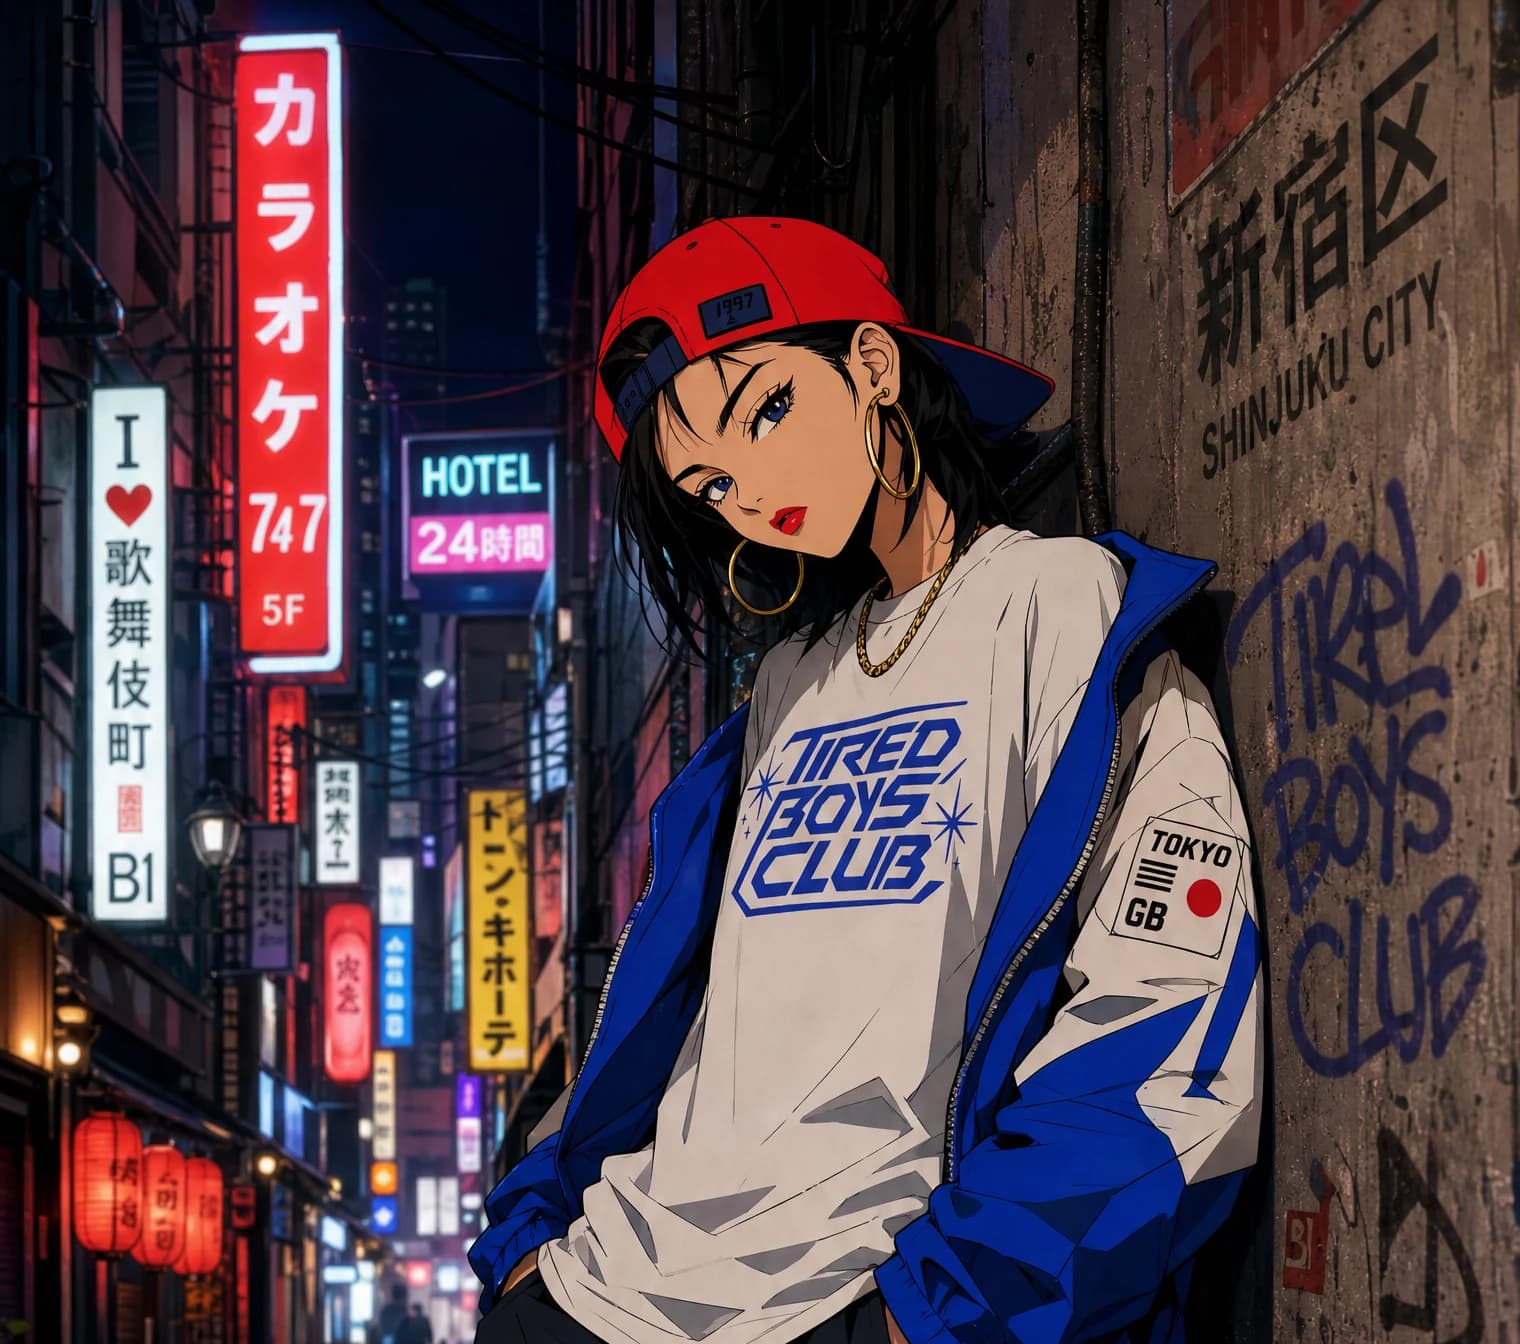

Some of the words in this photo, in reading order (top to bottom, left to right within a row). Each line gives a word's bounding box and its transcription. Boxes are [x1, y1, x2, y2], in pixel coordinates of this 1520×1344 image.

[1196, 33, 1448, 386] 新宿区
[252, 73, 318, 452] カラオケ
[716, 291, 753, 318] 1997
[1201, 326, 1350, 481] SHINJUKU
[1362, 258, 1442, 371] CITY
[115, 413, 140, 469] I
[422, 452, 543, 498] HOTEL
[248, 492, 328, 554] 747
[416, 519, 546, 565] 24時間
[262, 593, 305, 627] 5F
[105, 539, 152, 770] 歌舞伎町
[781, 700, 968, 786] TIRED
[760, 772, 944, 842] BOYS
[1262, 708, 1455, 916] BOYS
[108, 852, 153, 904] B1
[751, 834, 933, 899] CLUB
[1151, 829, 1233, 868] TOKYO
[1125, 897, 1168, 932] GB
[1287, 874, 1487, 1080] CLUB
